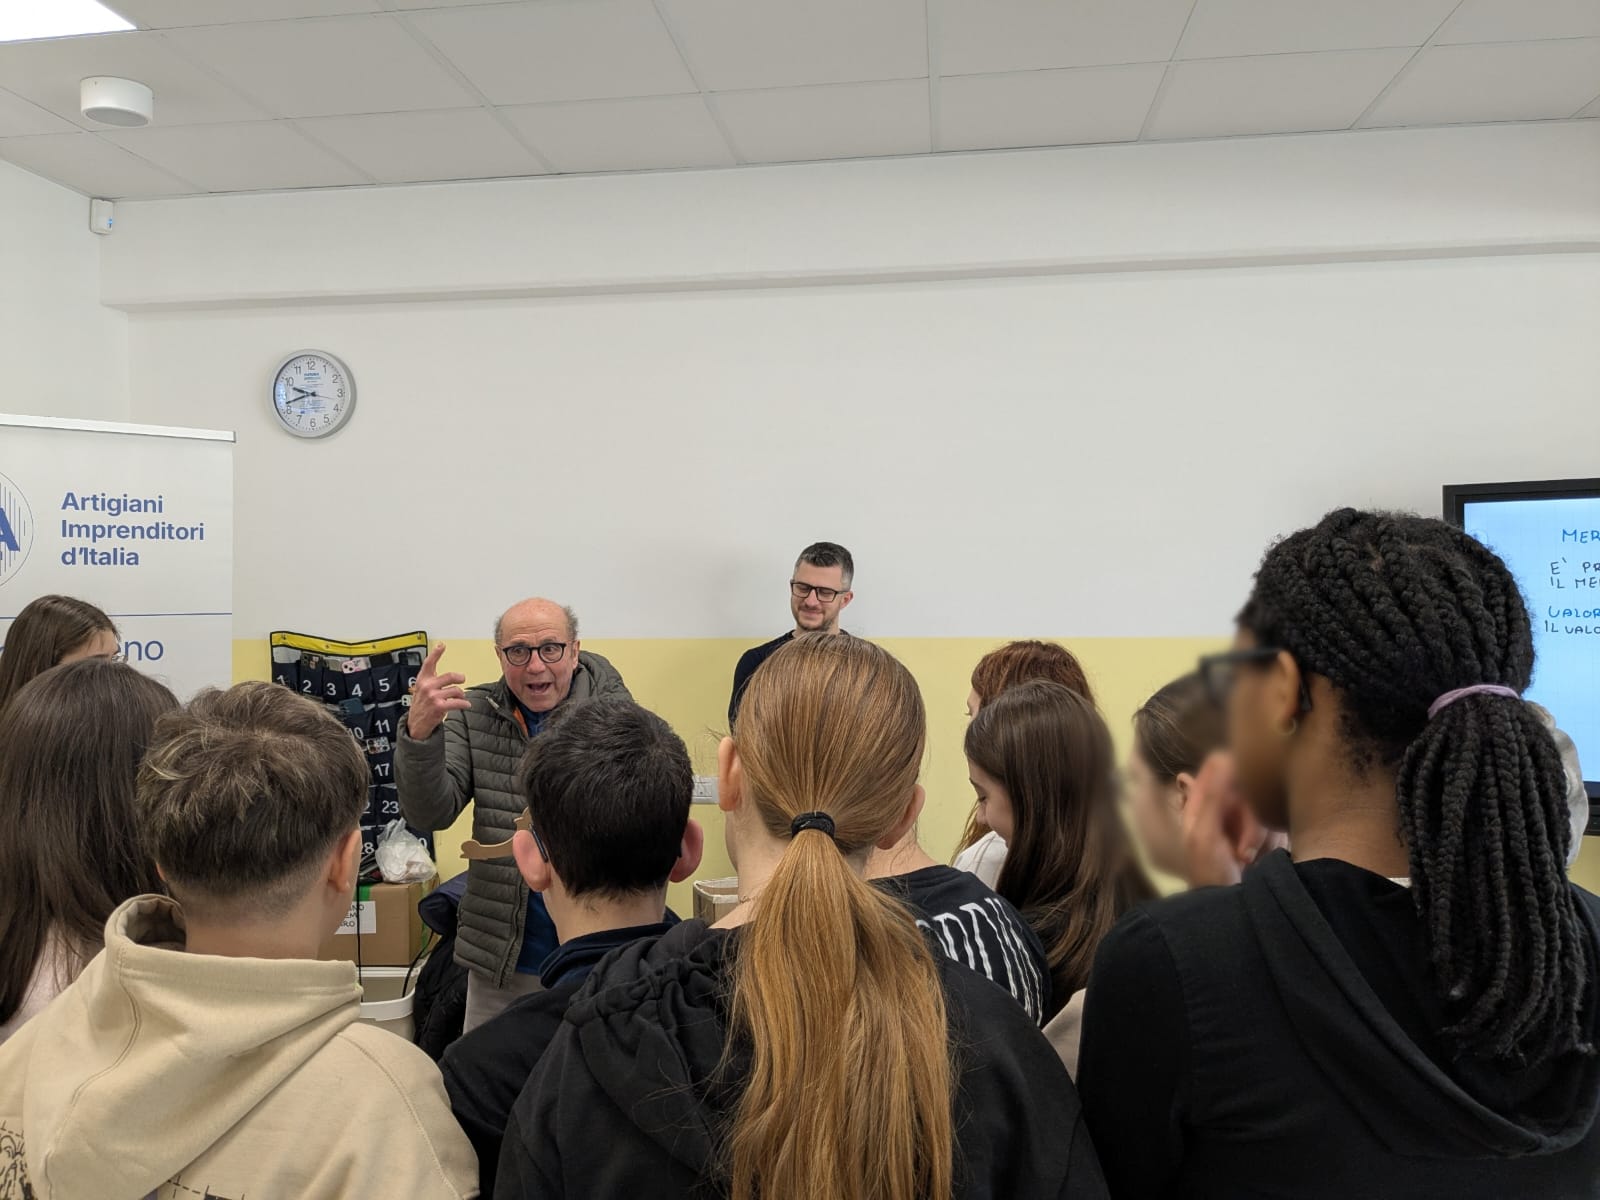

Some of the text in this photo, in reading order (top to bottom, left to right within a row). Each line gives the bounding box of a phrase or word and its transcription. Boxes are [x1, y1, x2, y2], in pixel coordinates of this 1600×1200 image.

[294, 365, 302, 375] 11
[306, 361, 316, 370] 12
[285, 376, 294, 387] 10
[332, 374, 339, 383] 2
[336, 388, 343, 398] 3
[333, 403, 339, 412] 4
[296, 415, 302, 424] 7
[309, 418, 316, 427] 6
[323, 414, 330, 423] 5
[61, 492, 163, 517] Artigiani
[61, 519, 205, 543] Imprenditori
[61, 547, 139, 566] d'Italia
[1575, 576, 1600, 589] ME
[124, 640, 164, 661] no
[302, 679, 312, 693] 2
[326, 682, 337, 696] 3
[351, 683, 363, 697] 4
[378, 677, 391, 692] 5
[374, 719, 391, 734] 11
[374, 763, 390, 777] 17
[381, 800, 400, 814] 23
